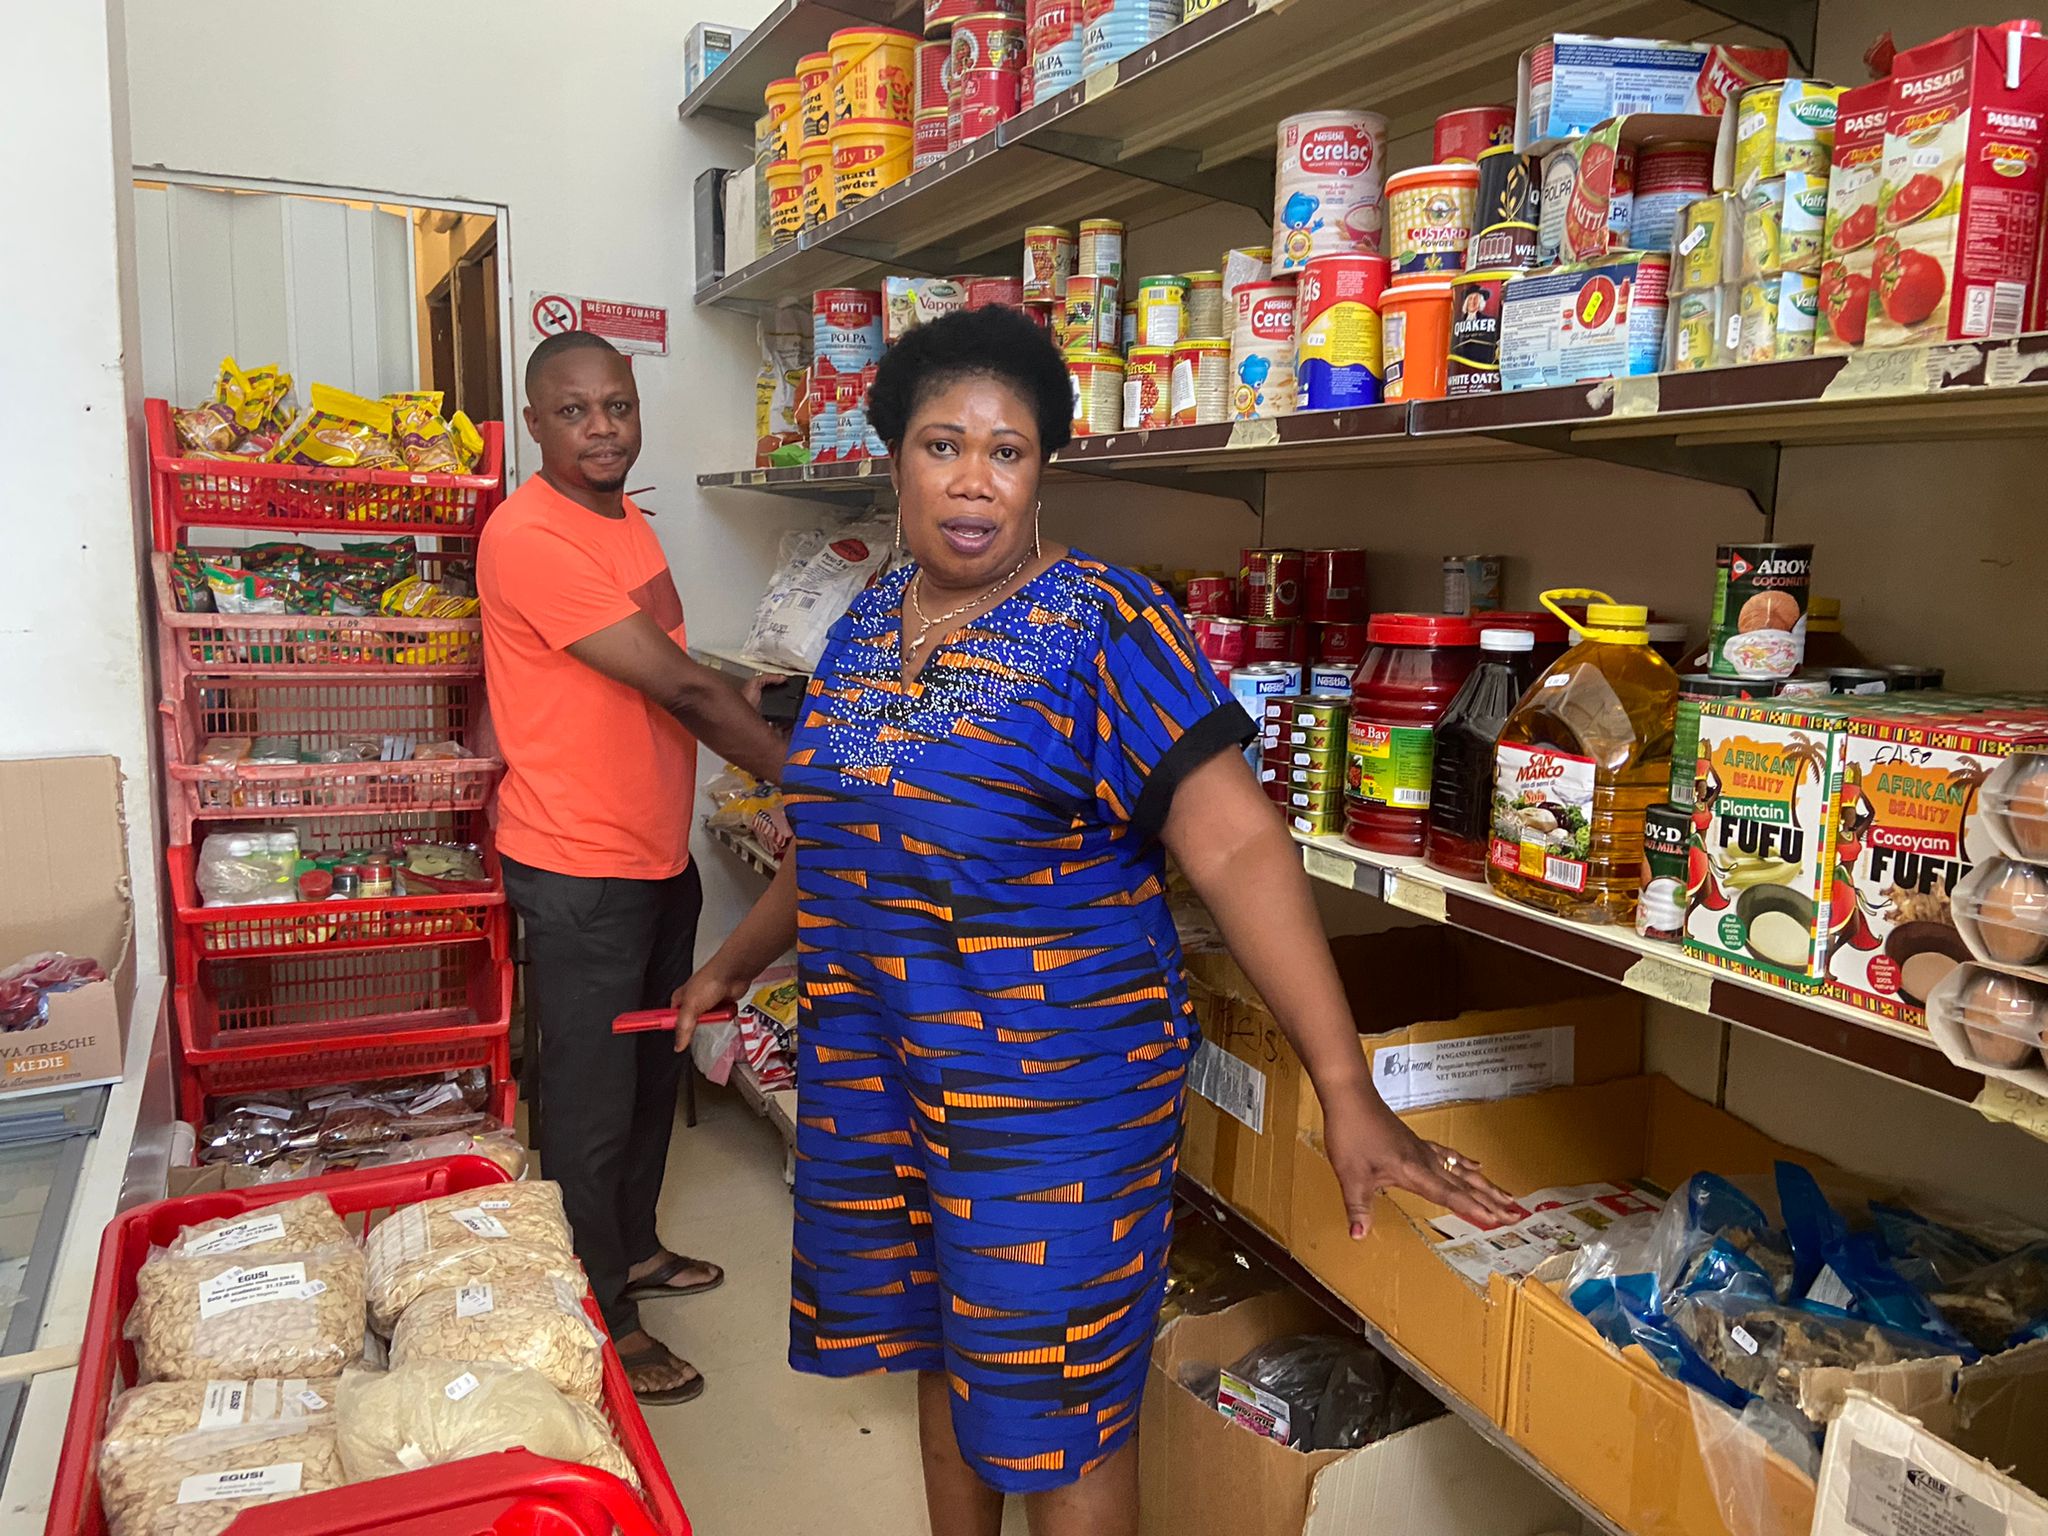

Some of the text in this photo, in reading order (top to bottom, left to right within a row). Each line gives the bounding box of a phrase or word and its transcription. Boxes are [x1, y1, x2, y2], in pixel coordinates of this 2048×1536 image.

[1901, 66, 1966, 99] PASSATA
[1986, 112, 2038, 131] PASSATA
[1313, 130, 1345, 143] Nestlé
[1301, 142, 1369, 162] Cerelac
[1543, 178, 1572, 203] POLPA
[1411, 227, 1468, 241] CUSTARD
[1420, 239, 1455, 248] POWDER
[586, 301, 661, 320] VIETATO FUMARE
[830, 301, 868, 315] MUTTI
[1253, 310, 1293, 329] Cere
[1453, 318, 1497, 336] QUAKER
[830, 332, 867, 345] POLPA
[1470, 372, 1500, 384] OATS
[1756, 558, 1811, 576] AROY-
[1316, 674, 1347, 687] Nestlé
[1367, 726, 1389, 744] Bay
[1527, 753, 1555, 769] SAN
[1723, 746, 1797, 778] AFRICAN
[1515, 764, 1564, 784] MARCO
[1732, 771, 1784, 795] BEAUTY
[1876, 771, 1966, 806] AFRICAN
[1719, 798, 1785, 821] Plantain
[1888, 800, 1950, 826] BEAUTY
[1645, 822, 1682, 843] OY-D
[1718, 814, 1805, 865] FUFU
[1871, 828, 1951, 854] Cocoyam
[1656, 841, 1684, 856] MILK
[0, 1035, 97, 1059] VA FRESCHE
[1436, 1040, 1465, 1050] SMOKED
[12, 1055, 65, 1074] MEDIE
[1436, 1050, 1471, 1061] PANGASIO
[1436, 1072, 1450, 1081] NET
[1451, 1068, 1479, 1080] WEIGHT
[237, 1270, 269, 1283] EGUSI
[219, 1470, 264, 1483] EGUSI
